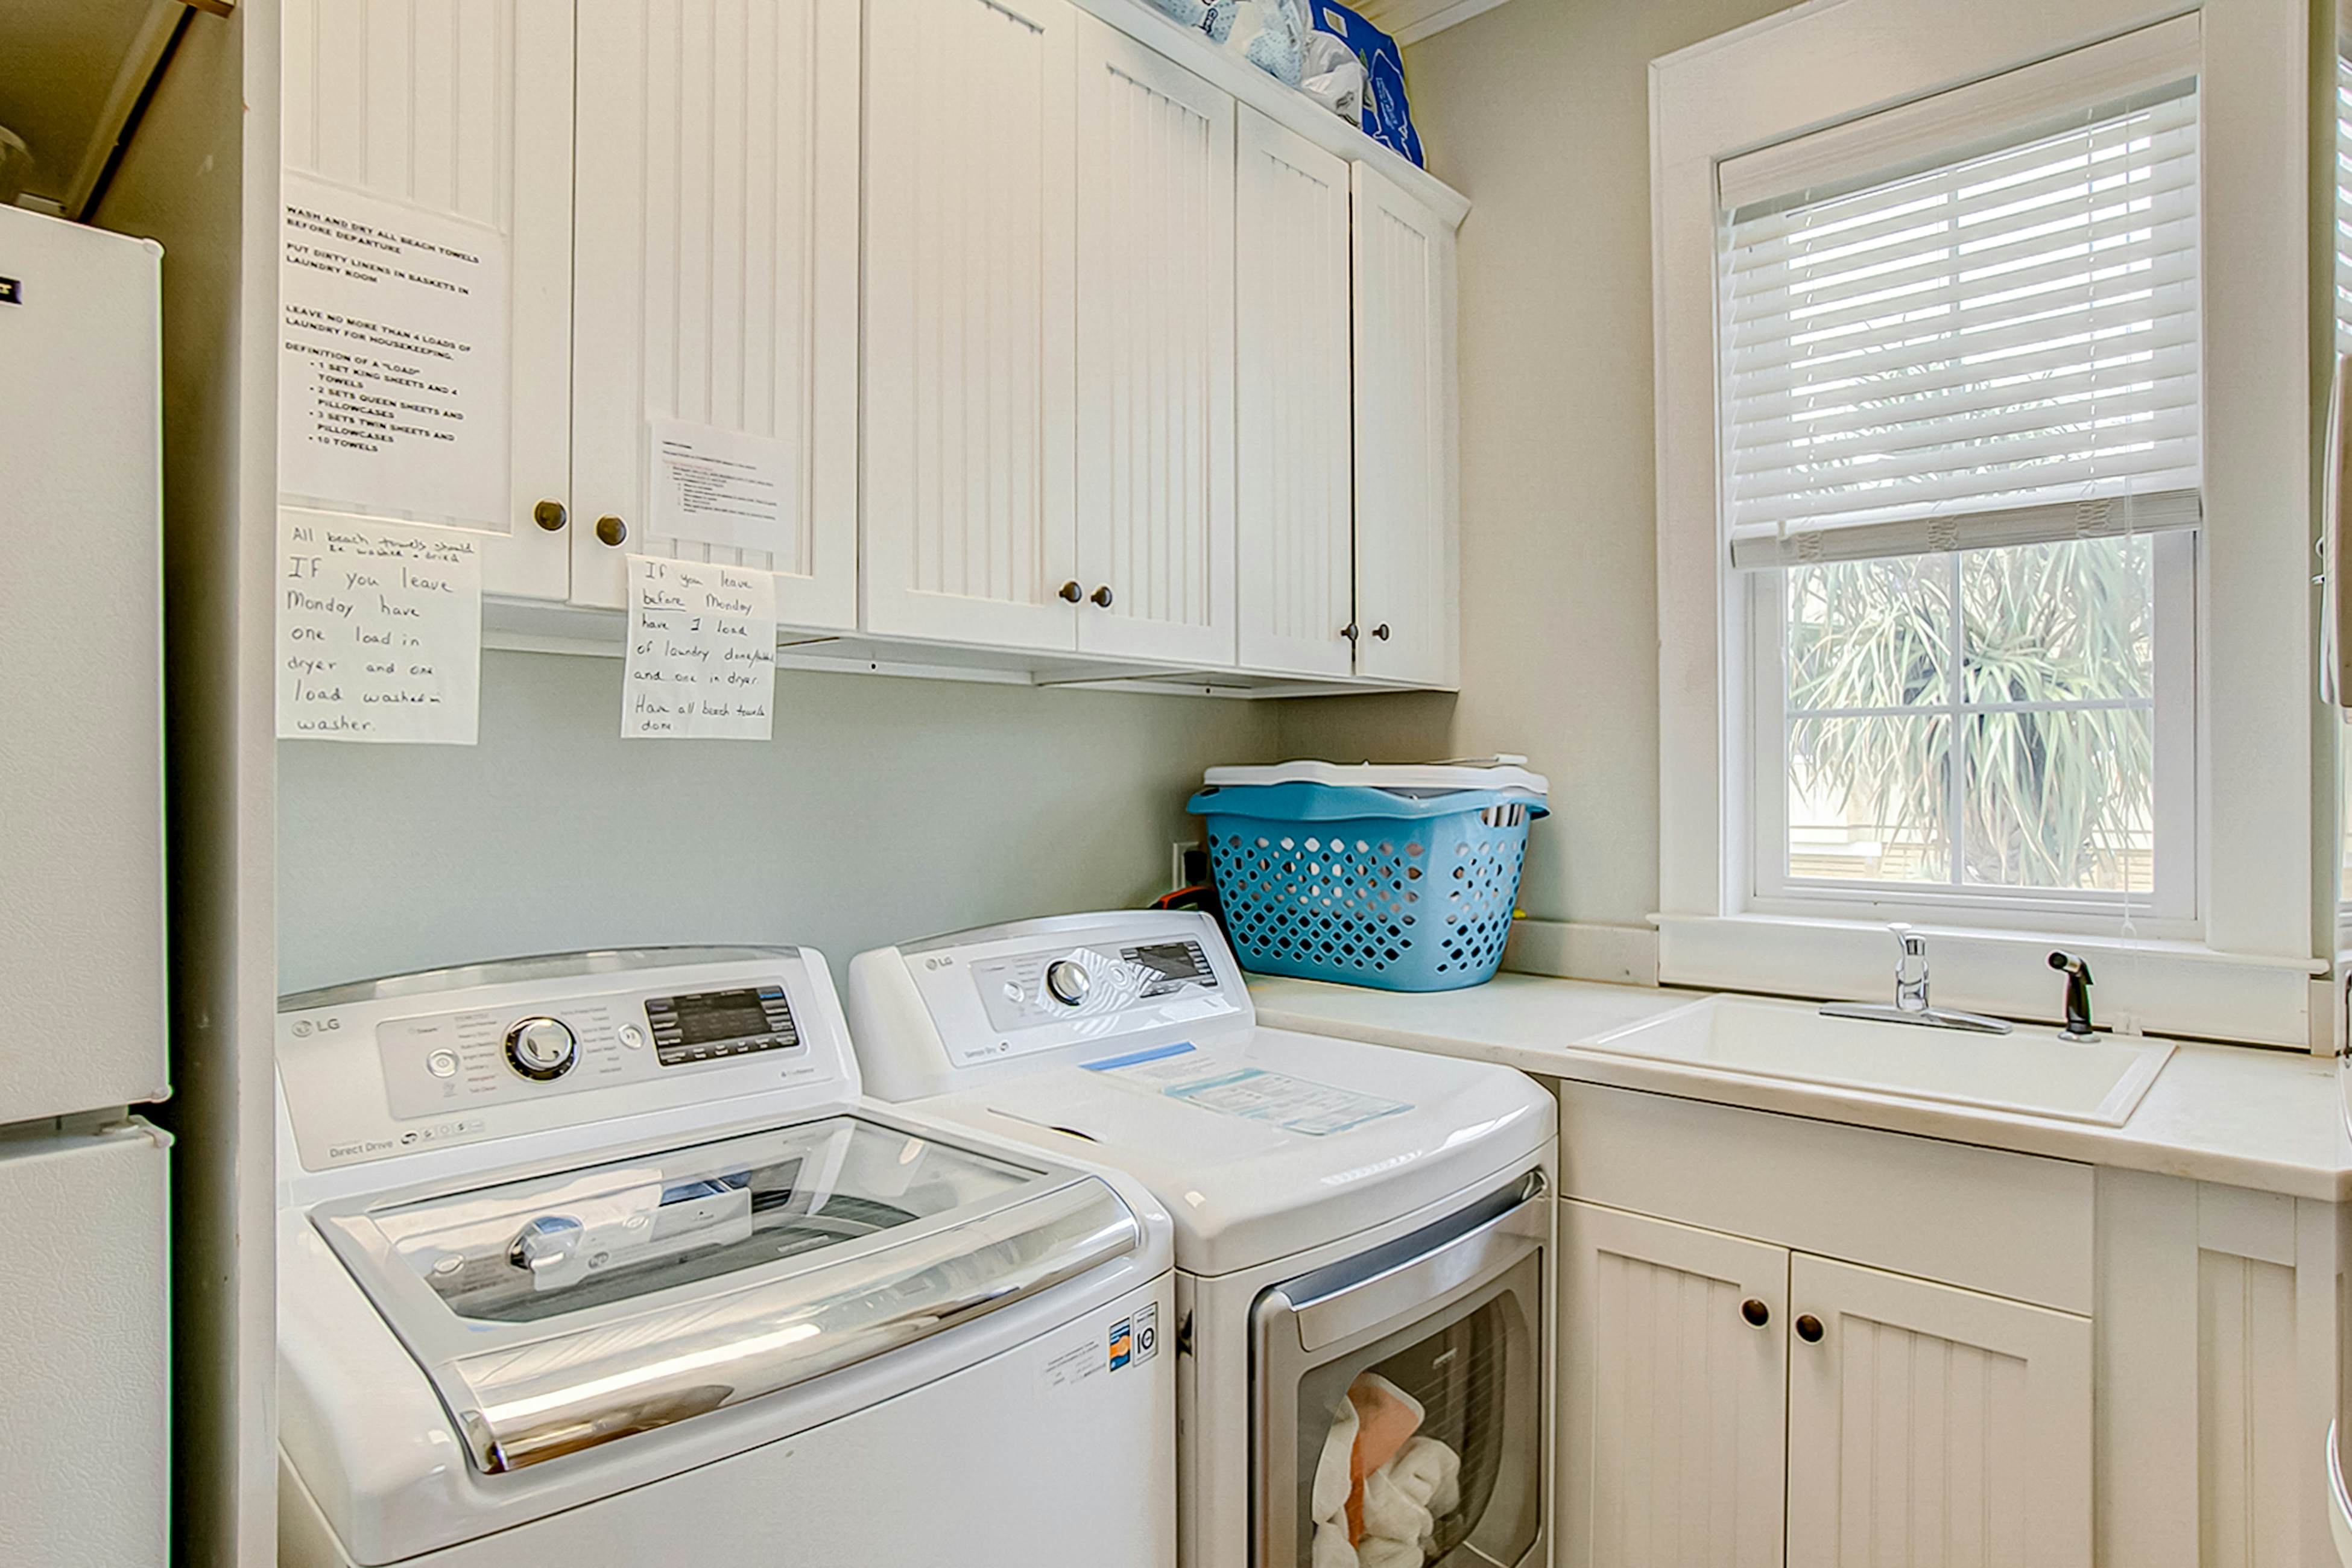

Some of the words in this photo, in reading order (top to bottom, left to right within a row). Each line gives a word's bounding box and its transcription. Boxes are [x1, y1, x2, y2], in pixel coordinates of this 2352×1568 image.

[286, 206, 321, 221] WASH
[324, 217, 348, 229] AND
[351, 223, 373, 235] DRY
[377, 231, 397, 242] ALL
[400, 236, 436, 251] BEACH
[438, 247, 479, 264] TOWELS
[286, 218, 332, 236] BEFORE
[336, 231, 401, 254] DEPARTURE
[286, 242, 309, 254] PUT
[314, 249, 347, 263] DIRTY
[351, 259, 391, 275] LINENS
[394, 270, 405, 279] IN
[408, 274, 455, 292] BASKETS
[286, 255, 341, 273] LAUNDRY
[345, 270, 378, 283] ROOM
[285, 317, 341, 335] LAUNDRY
[344, 330, 366, 341] FOR
[286, 305, 322, 319] LEAVE
[326, 314, 344, 324] NO
[346, 318, 377, 332] MORE
[381, 326, 411, 339] THAN
[422, 336, 456, 349] LOADS
[285, 342, 351, 362] DEFINITION
[354, 356, 368, 365] OF
[318, 373, 364, 389] TOWELS
[329, 364, 349, 373] SET
[353, 369, 381, 380] KING
[384, 375, 425, 389] SHEETS
[427, 384, 449, 394] AND
[318, 399, 394, 419] PILLOWCASES
[328, 388, 356, 400] SETS
[359, 394, 397, 407] QUEEN
[400, 402, 440, 416] SHEETS
[443, 411, 464, 420] AND
[317, 423, 394, 443] PILLOWCASES
[327, 413, 355, 424] SETS
[359, 418, 387, 429] TWIN
[390, 424, 431, 437] SHEETS
[433, 432, 455, 441] AND
[318, 436, 330, 444] 10
[333, 438, 378, 452] TOWELS
[292, 528, 313, 542] All
[346, 572, 379, 590] you
[402, 566, 454, 593] leave
[680, 574, 703, 588] you
[721, 570, 753, 589] leave
[286, 590, 354, 618] Monday
[379, 594, 420, 617] have
[643, 588, 686, 607] before
[706, 592, 753, 616] Monday
[642, 613, 669, 630] have
[717, 619, 748, 636] load
[291, 628, 325, 640] one
[356, 626, 391, 645] load
[402, 634, 420, 646] in
[637, 640, 653, 654] of
[665, 640, 710, 662] laundry
[287, 656, 337, 675] dryer
[366, 663, 395, 673] and
[409, 665, 434, 675] one
[634, 671, 663, 680] and
[675, 673, 697, 683] one
[709, 675, 719, 683] in
[294, 678, 344, 701] load
[678, 701, 695, 714] all
[641, 720, 672, 731] done
[938, 957, 953, 966] LG
[316, 1019, 340, 1032] LG
[329, 1144, 363, 1158] Direct
[365, 1140, 394, 1152] Drive
